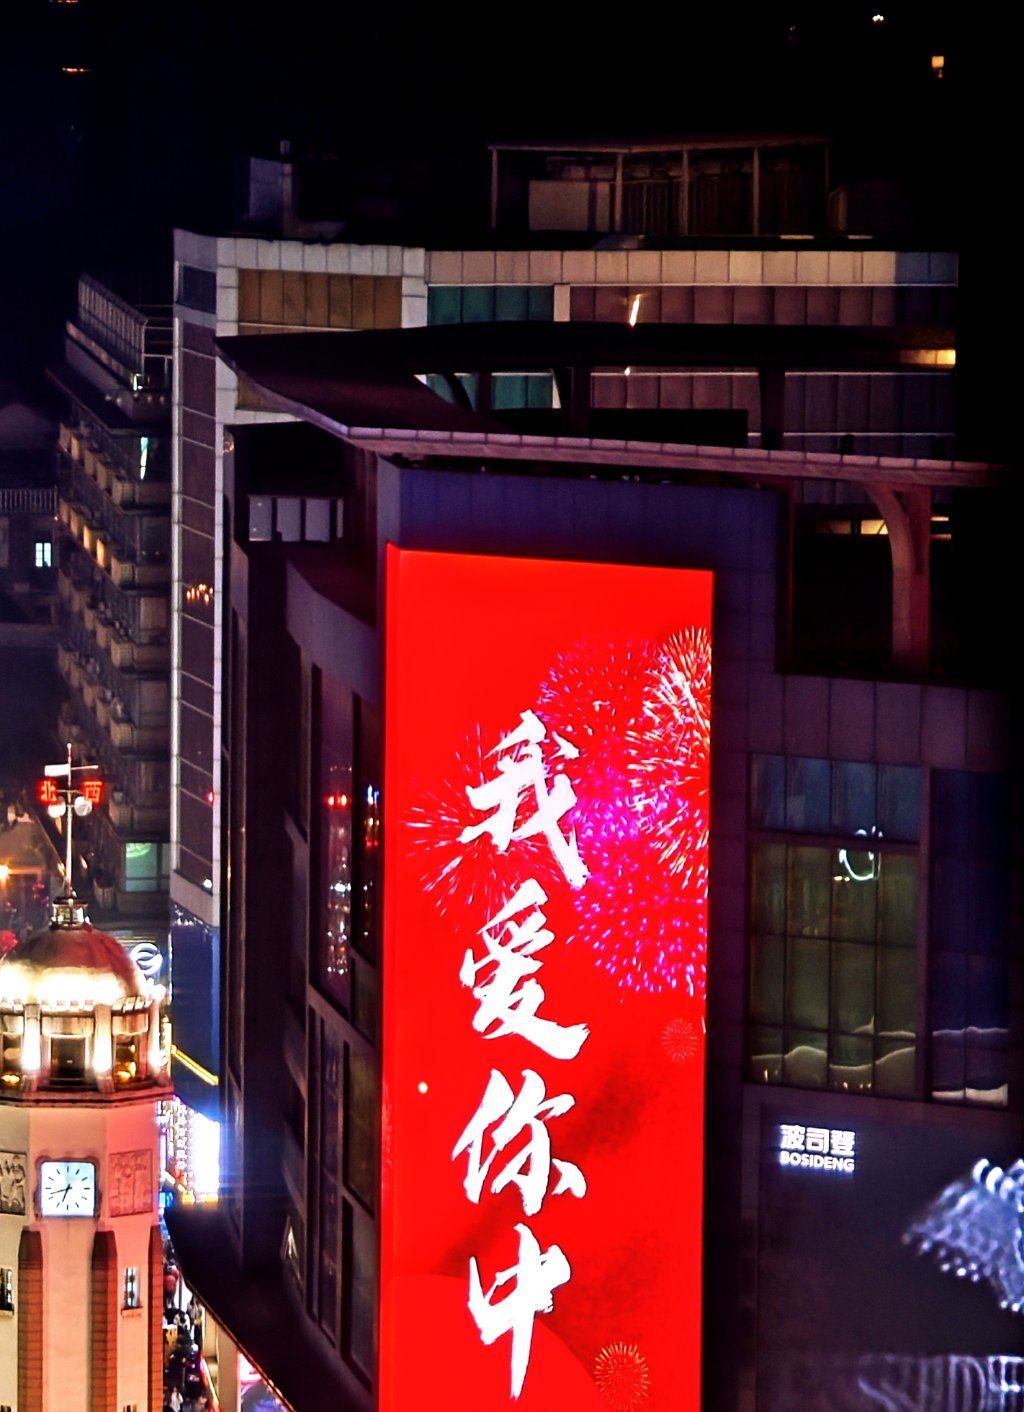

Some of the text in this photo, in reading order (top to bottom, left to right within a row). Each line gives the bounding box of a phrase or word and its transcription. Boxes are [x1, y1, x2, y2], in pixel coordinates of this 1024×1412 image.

[41, 780, 57, 802] 北
[84, 781, 102, 803] 西
[780, 1124, 855, 1156] 波司登
[780, 1150, 855, 1173] BOSIDENG
